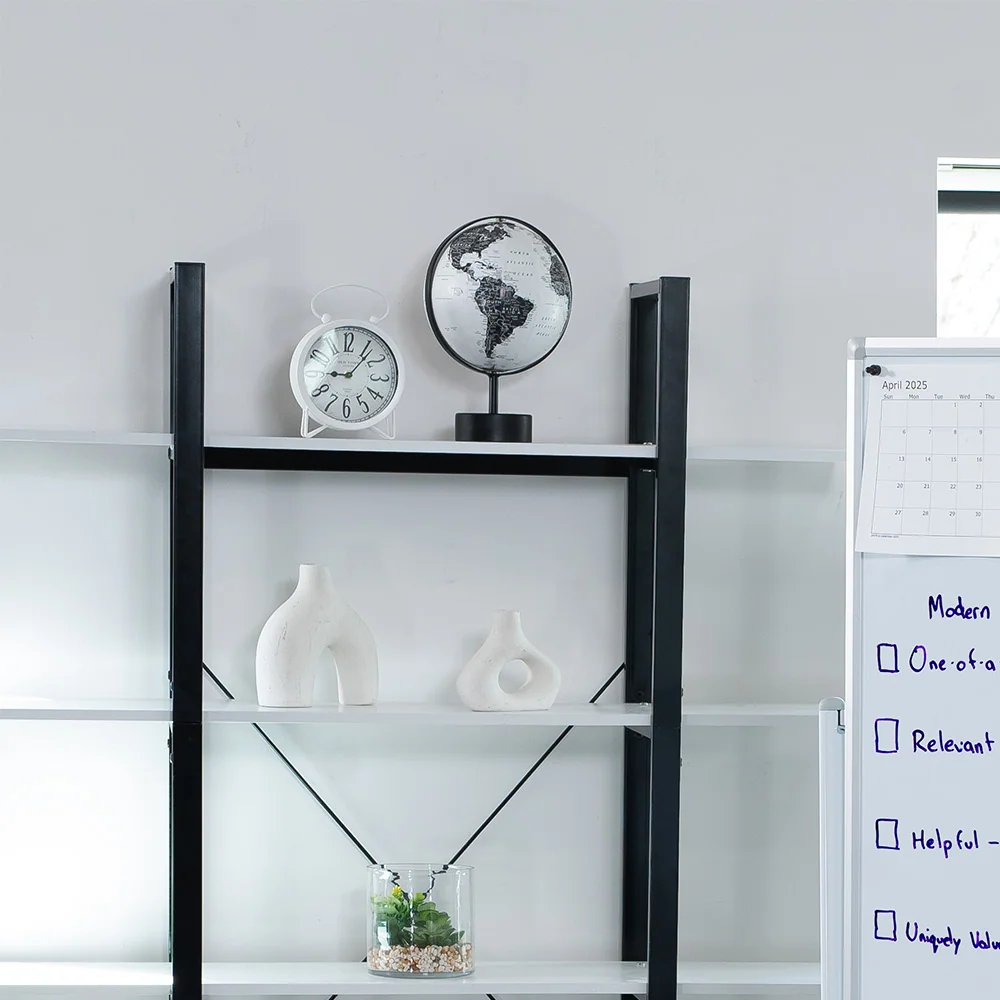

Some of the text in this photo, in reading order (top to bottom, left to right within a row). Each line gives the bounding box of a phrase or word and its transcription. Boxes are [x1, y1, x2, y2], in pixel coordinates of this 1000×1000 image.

[343, 331, 355, 353] 12
[366, 354, 385, 368] 2
[370, 373, 390, 383] 3
[882, 380, 927, 391] April 2025
[311, 384, 329, 397] 8
[366, 386, 384, 401] 4
[324, 394, 338, 412] 7
[342, 398, 351, 418] 6
[356, 394, 369, 414] 5
[929, 594, 990, 619] Modern
[912, 729, 994, 754] Relevant
[912, 828, 978, 858] Helpful
[906, 922, 961, 955] Uniquely
